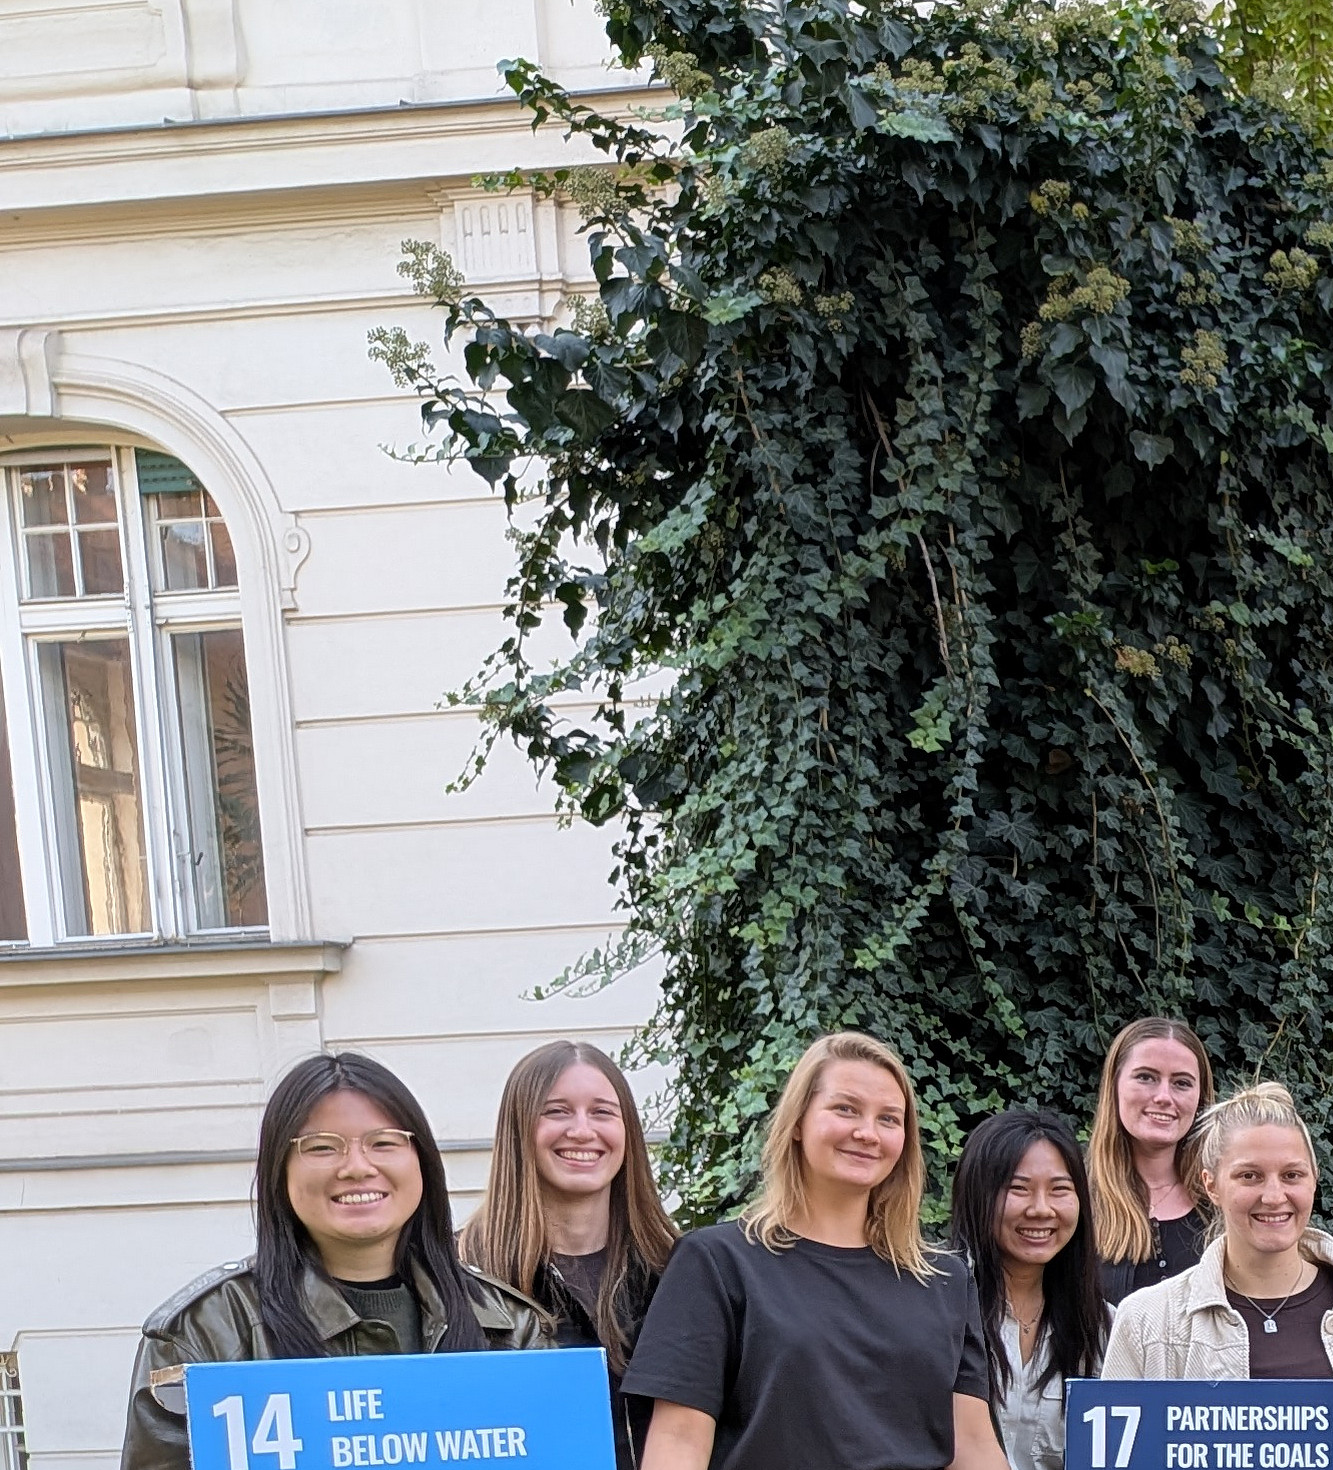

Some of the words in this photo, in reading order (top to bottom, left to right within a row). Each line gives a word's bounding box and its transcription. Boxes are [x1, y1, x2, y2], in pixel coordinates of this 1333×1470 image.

[327, 1388, 384, 1422] LIFE
[1166, 1405, 1330, 1431] PARTNERSHIPS
[331, 1432, 428, 1468] BELOW
[435, 1427, 528, 1461] WATER
[1082, 1405, 1142, 1468] 17
[1166, 1443, 1209, 1469] FOR
[1212, 1442, 1254, 1469] THE
[1259, 1442, 1330, 1469] GOALS
